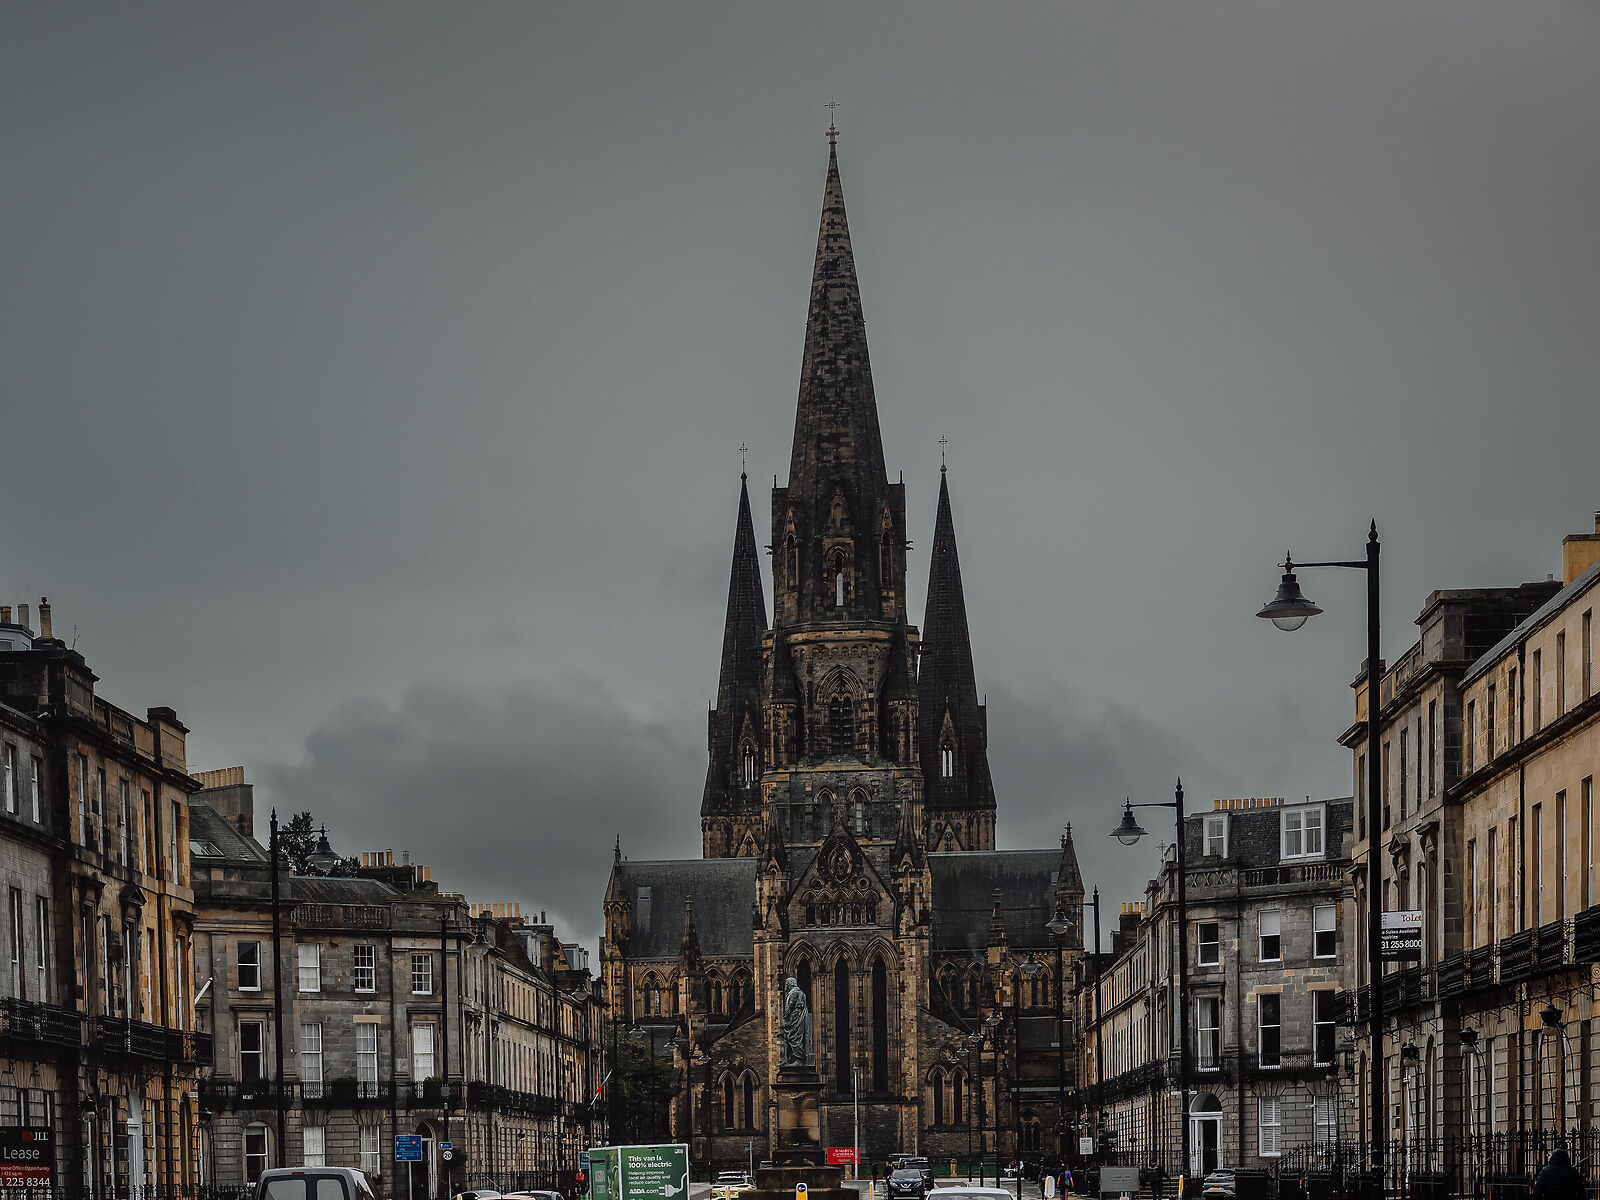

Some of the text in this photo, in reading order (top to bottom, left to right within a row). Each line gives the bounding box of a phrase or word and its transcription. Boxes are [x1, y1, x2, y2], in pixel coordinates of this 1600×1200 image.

[1390, 940, 1404, 949] 255
[1405, 939, 1422, 948] 8000
[33, 1132, 48, 1140] JLL
[4, 1146, 40, 1160] Lease
[6, 1178, 24, 1186] 225
[26, 1178, 50, 1186] 8344
